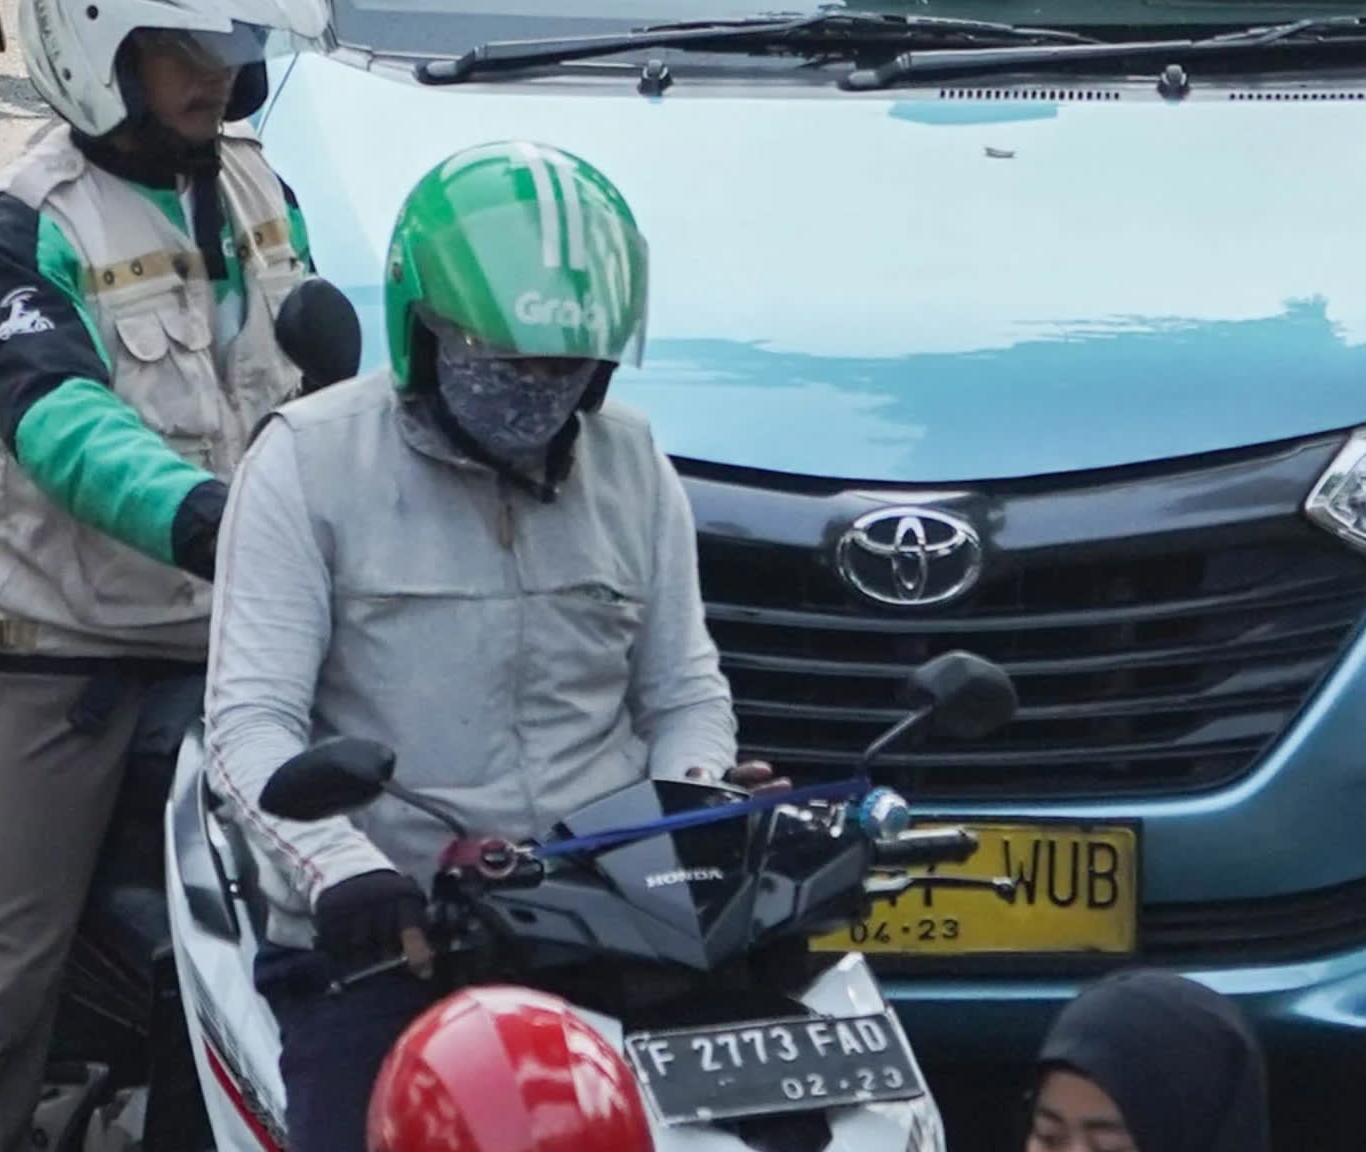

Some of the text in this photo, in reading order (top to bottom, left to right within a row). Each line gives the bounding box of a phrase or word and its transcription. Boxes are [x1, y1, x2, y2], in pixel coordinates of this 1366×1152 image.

[644, 869, 723, 888] HONDA
[1001, 839, 1119, 908] WUB
[648, 1018, 887, 1076] F 2773 FAD
